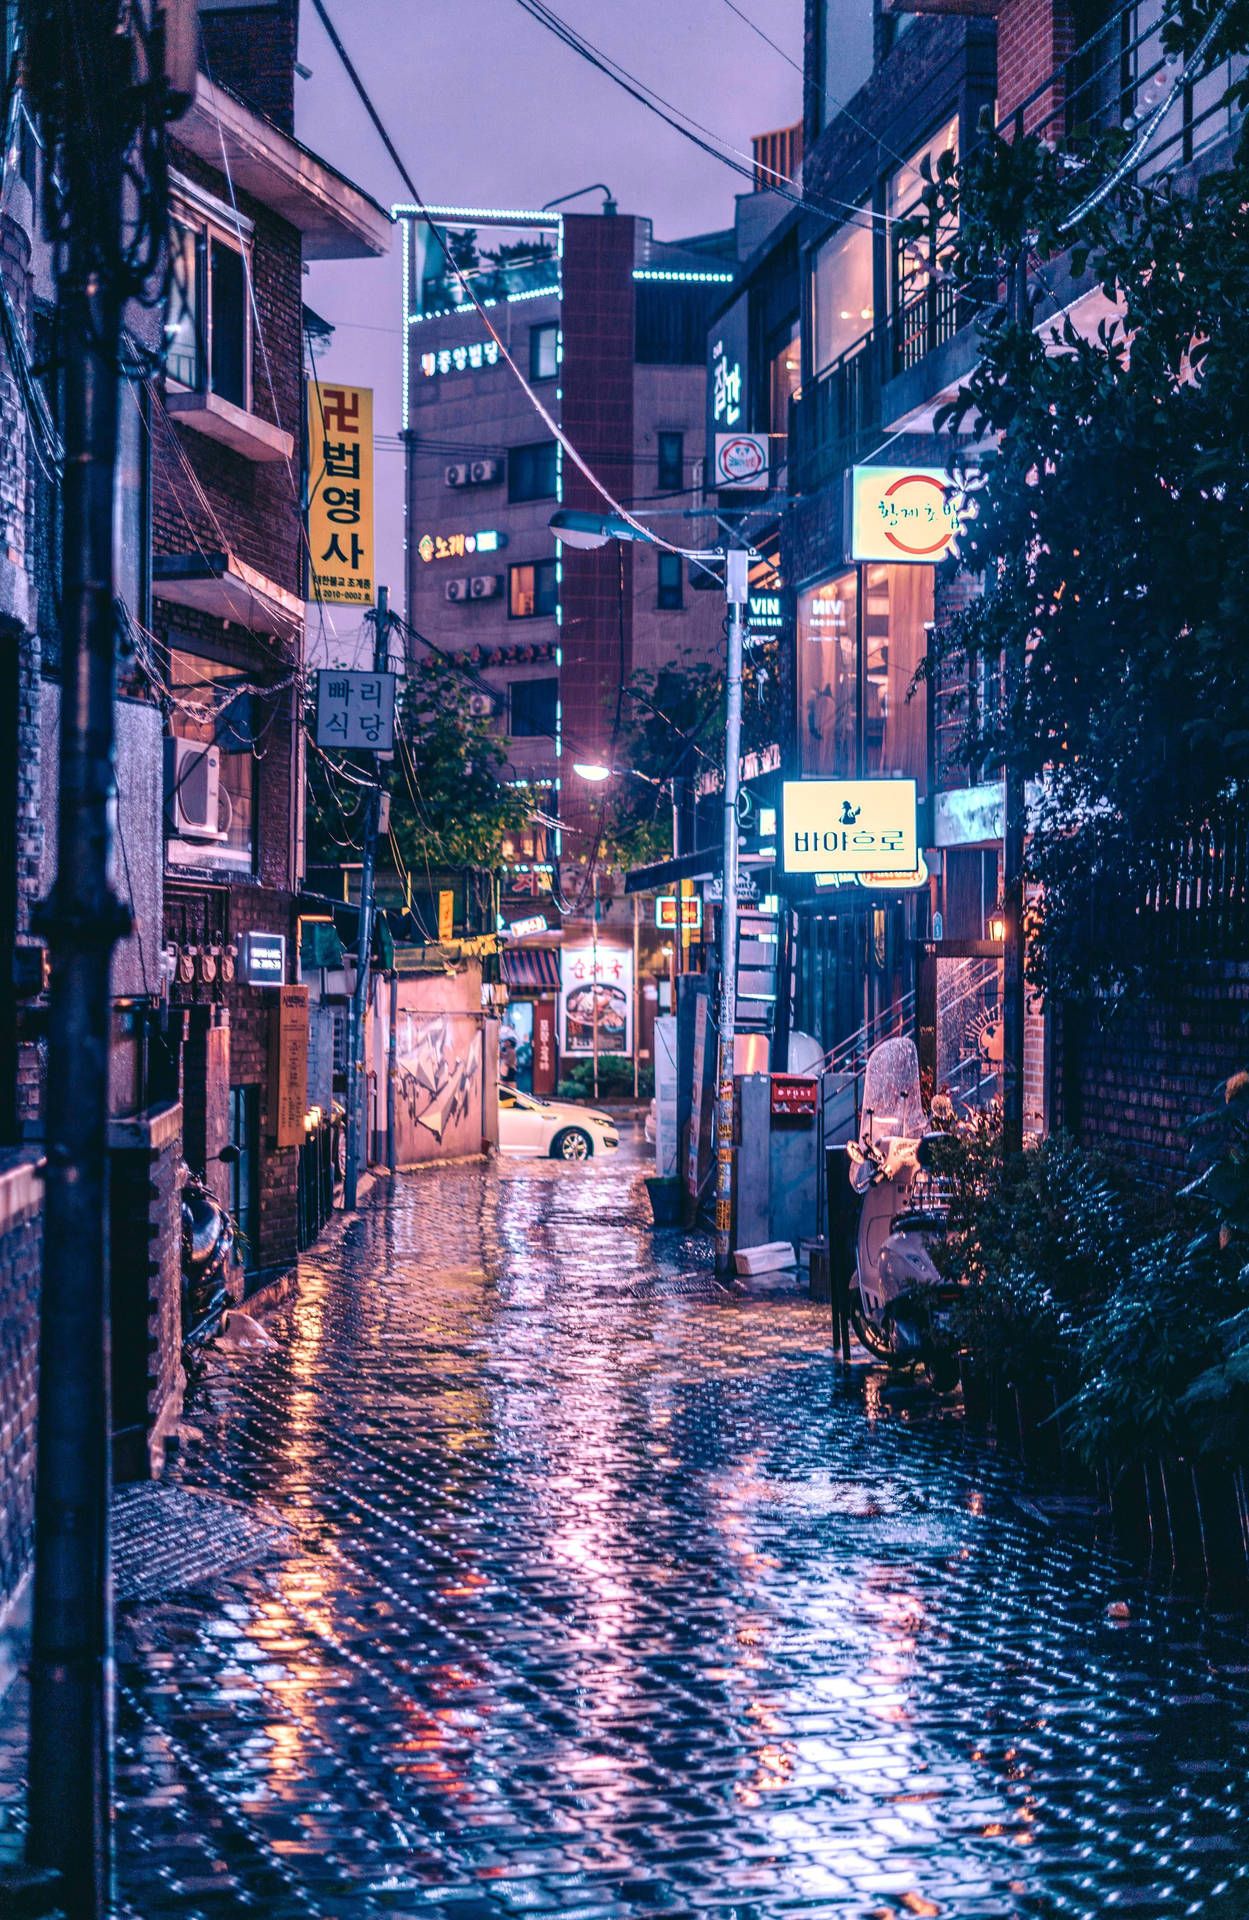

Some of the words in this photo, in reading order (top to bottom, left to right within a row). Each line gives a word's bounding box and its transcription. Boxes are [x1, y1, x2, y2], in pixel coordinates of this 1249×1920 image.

[321, 441, 364, 570] 법영사
[750, 598, 779, 615] VIN
[767, 617, 782, 627] BAR
[328, 678, 382, 708] 빠리
[325, 712, 386, 742] 식당
[795, 830, 905, 852] 바야흐로
